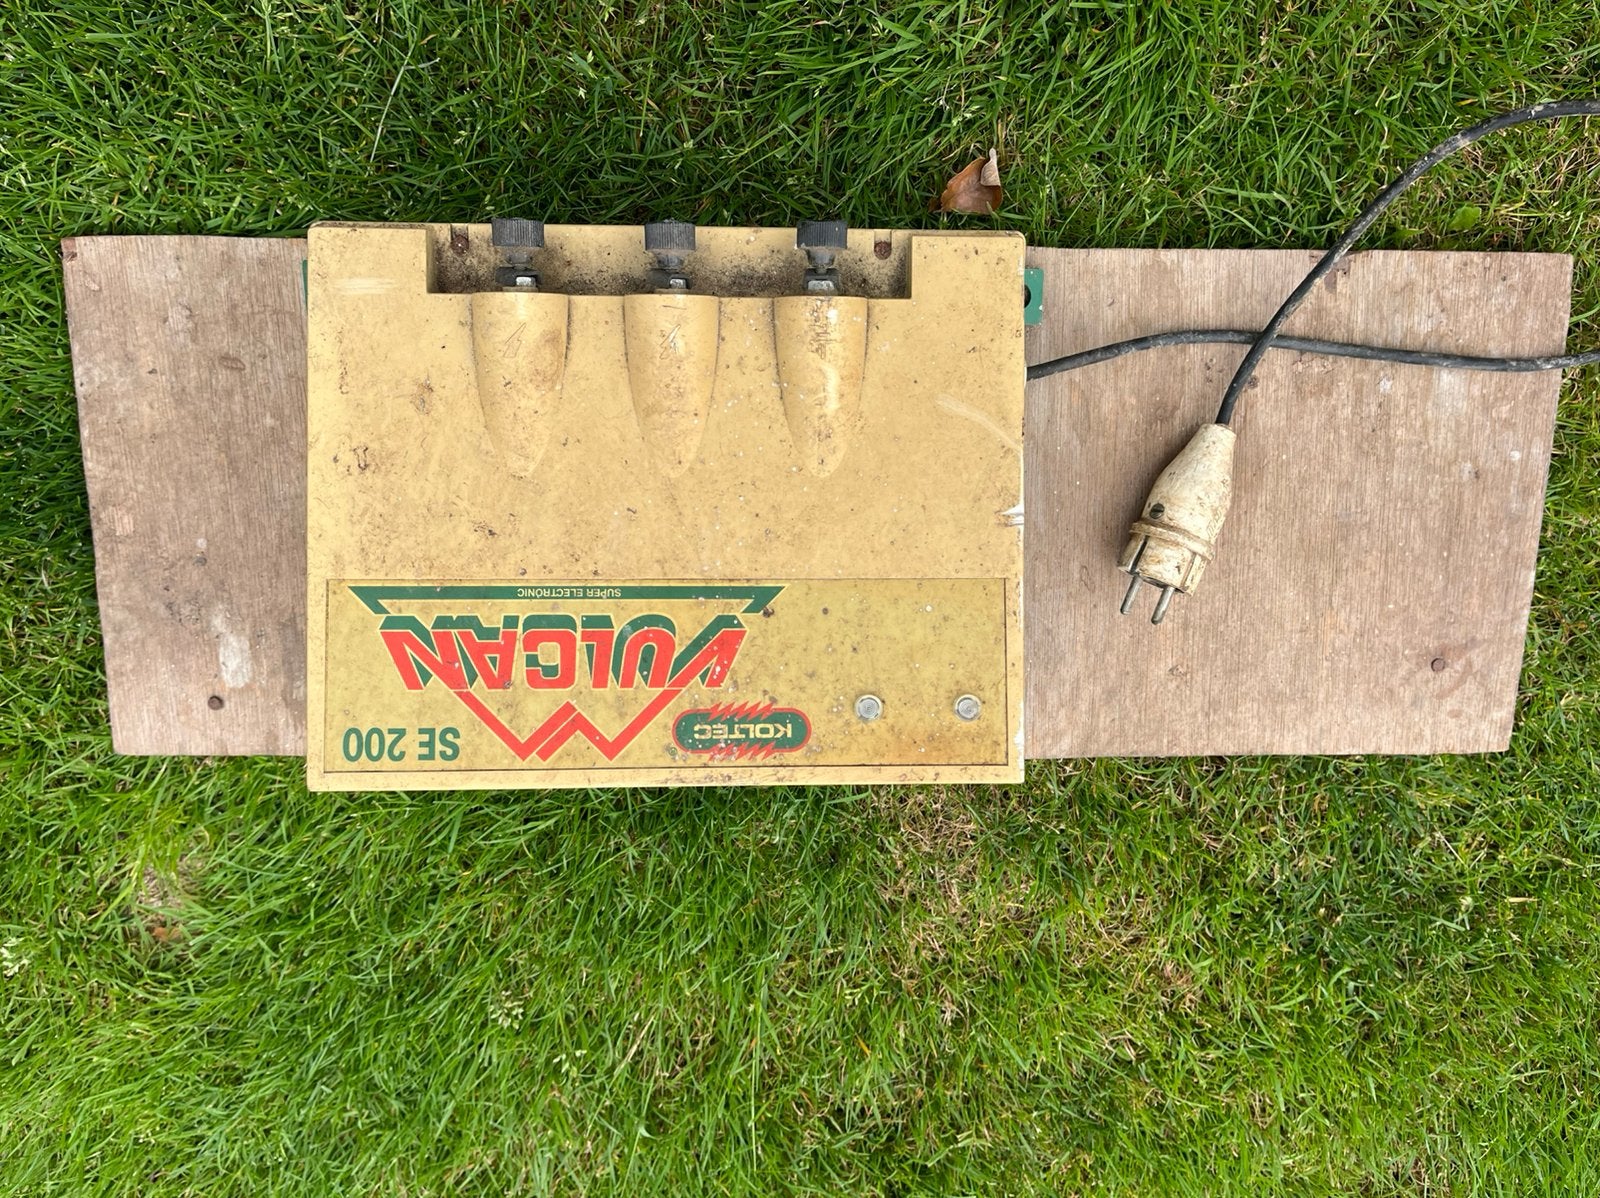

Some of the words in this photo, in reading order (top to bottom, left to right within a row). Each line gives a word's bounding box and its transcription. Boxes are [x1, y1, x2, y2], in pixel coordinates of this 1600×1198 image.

[516, 588, 584, 599] ELECTRONIC
[586, 588, 622, 598] SUPER
[379, 614, 748, 690] VULCAN
[693, 722, 792, 739] KOLTEC
[342, 726, 407, 762] 200
[417, 726, 461, 762] SE
